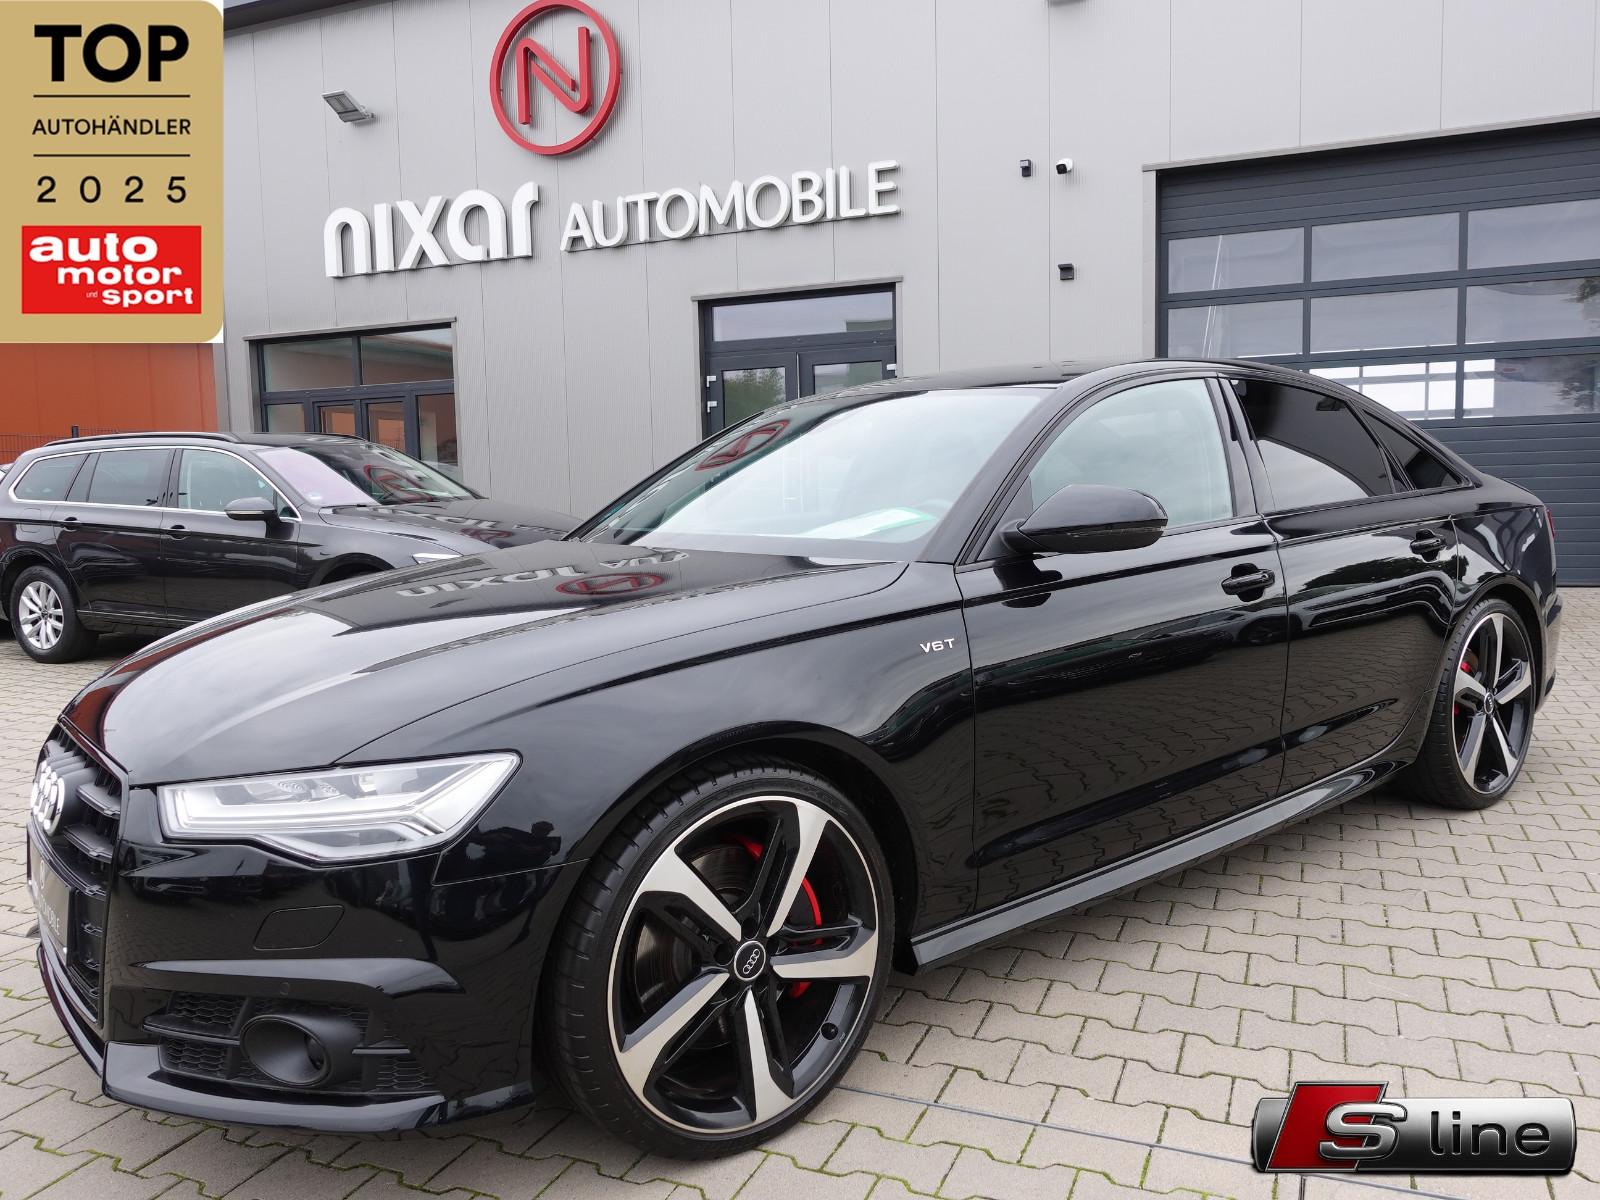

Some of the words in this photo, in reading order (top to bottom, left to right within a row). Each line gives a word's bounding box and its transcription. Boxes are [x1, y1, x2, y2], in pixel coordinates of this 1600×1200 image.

[324, 181, 540, 278] nixar
[560, 160, 900, 252] AUTOMOBILE
[920, 638, 955, 653] V6T
